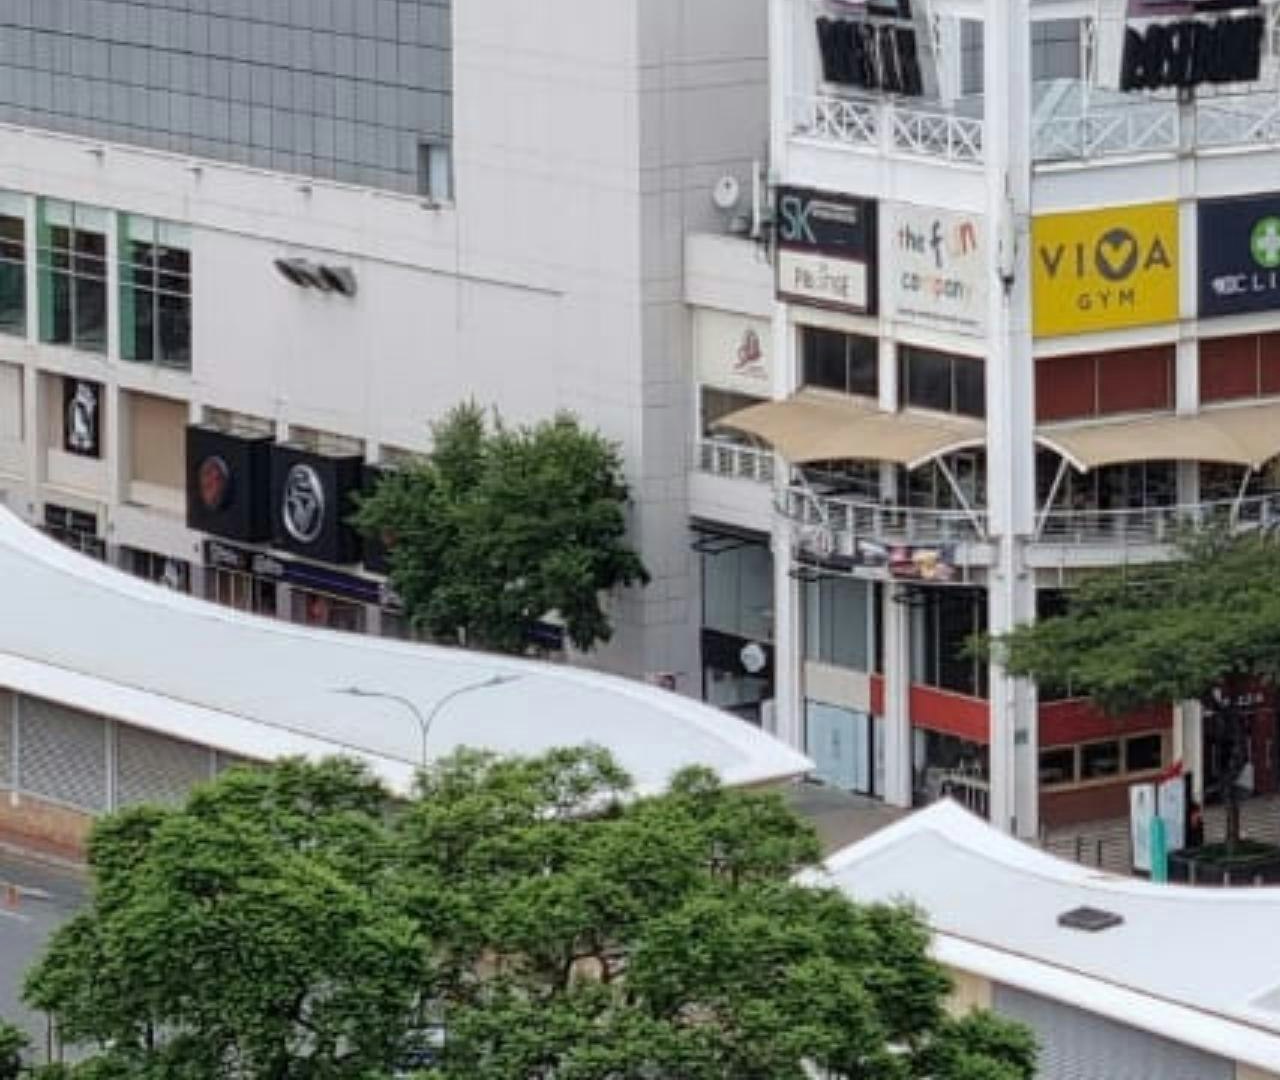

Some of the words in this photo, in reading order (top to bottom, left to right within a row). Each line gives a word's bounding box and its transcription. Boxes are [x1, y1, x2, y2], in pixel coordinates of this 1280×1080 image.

[931, 219, 977, 269] fn
[1040, 228, 1171, 281] VIVA
[1077, 289, 1136, 312] GYM
